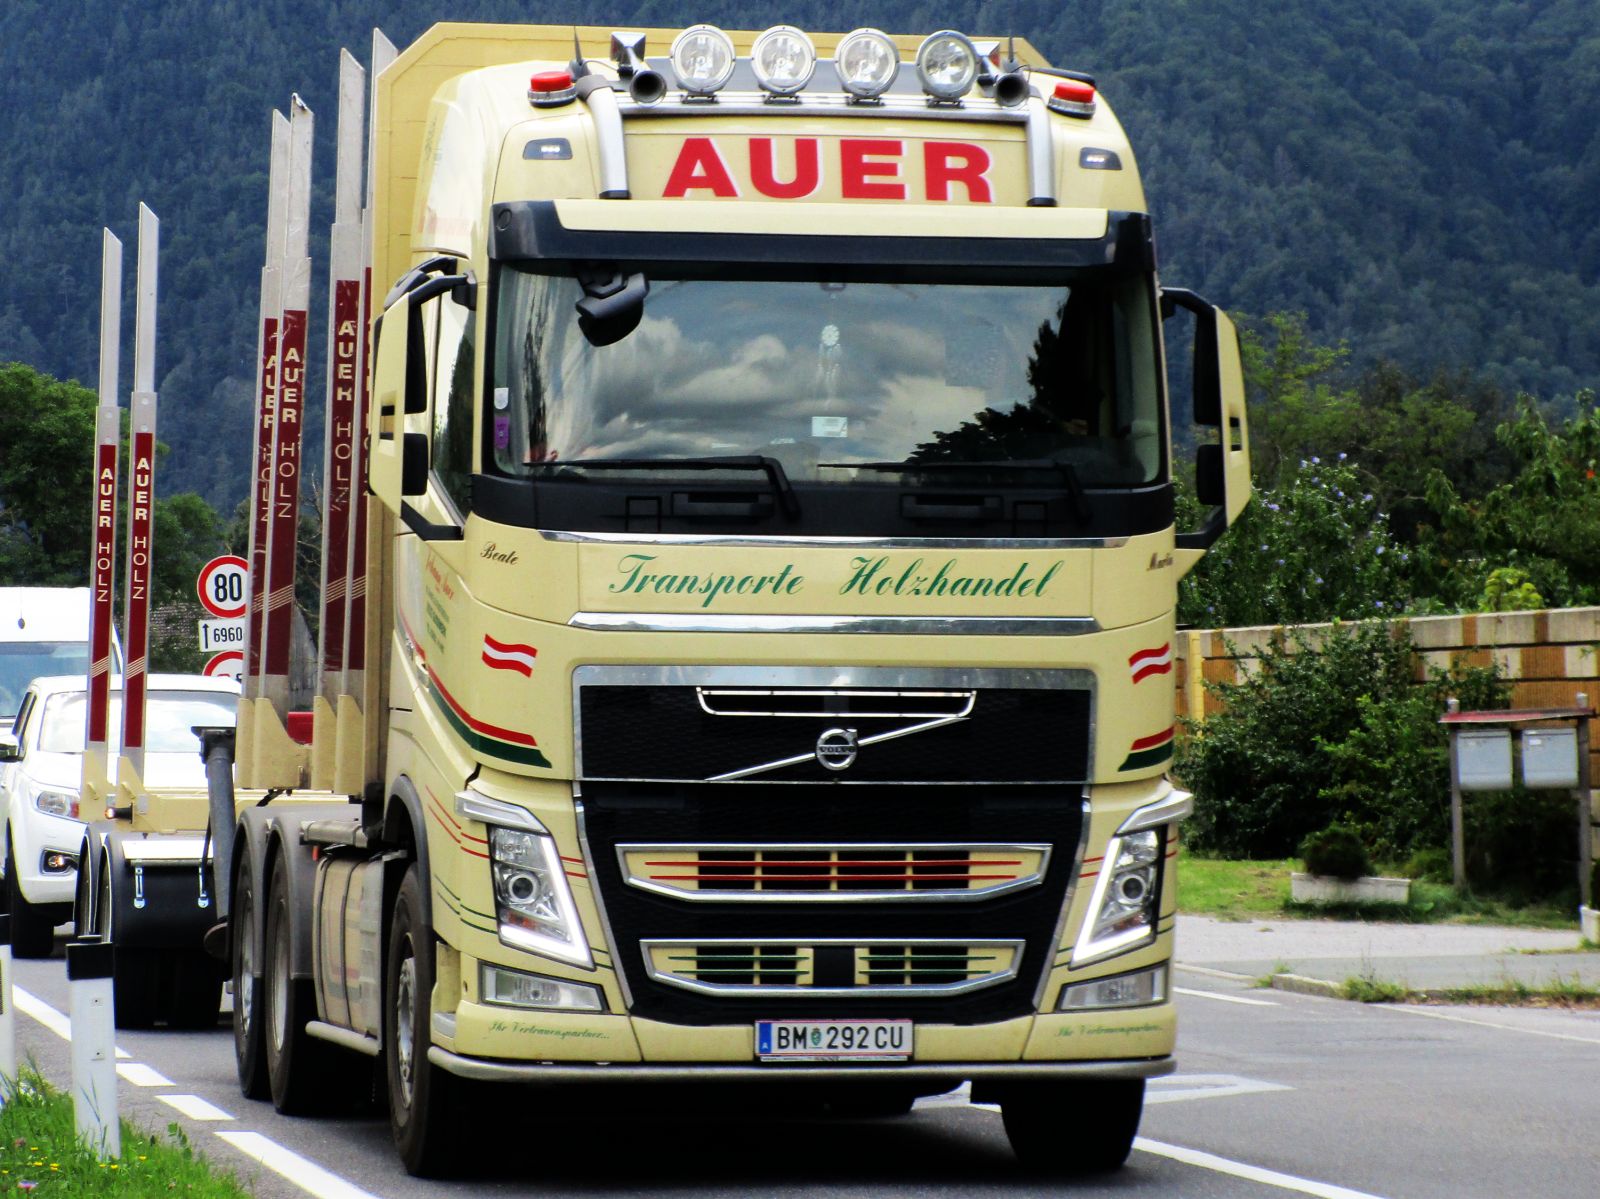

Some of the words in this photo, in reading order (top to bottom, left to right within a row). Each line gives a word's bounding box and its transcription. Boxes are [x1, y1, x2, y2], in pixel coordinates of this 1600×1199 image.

[662, 137, 993, 203] AUER
[282, 347, 300, 423] AUER
[99, 468, 114, 528] AUER
[134, 457, 150, 521] AUER
[278, 442, 296, 518] HOLZ
[97, 542, 111, 602] HOLZ
[132, 536, 147, 600] HOLZ
[480, 541, 519, 565] Beate
[608, 554, 804, 608] Transporte
[839, 556, 1066, 598] Holzhandel
[214, 573, 242, 602] 80
[213, 627, 243, 642] 6960
[777, 1026, 807, 1049] BM
